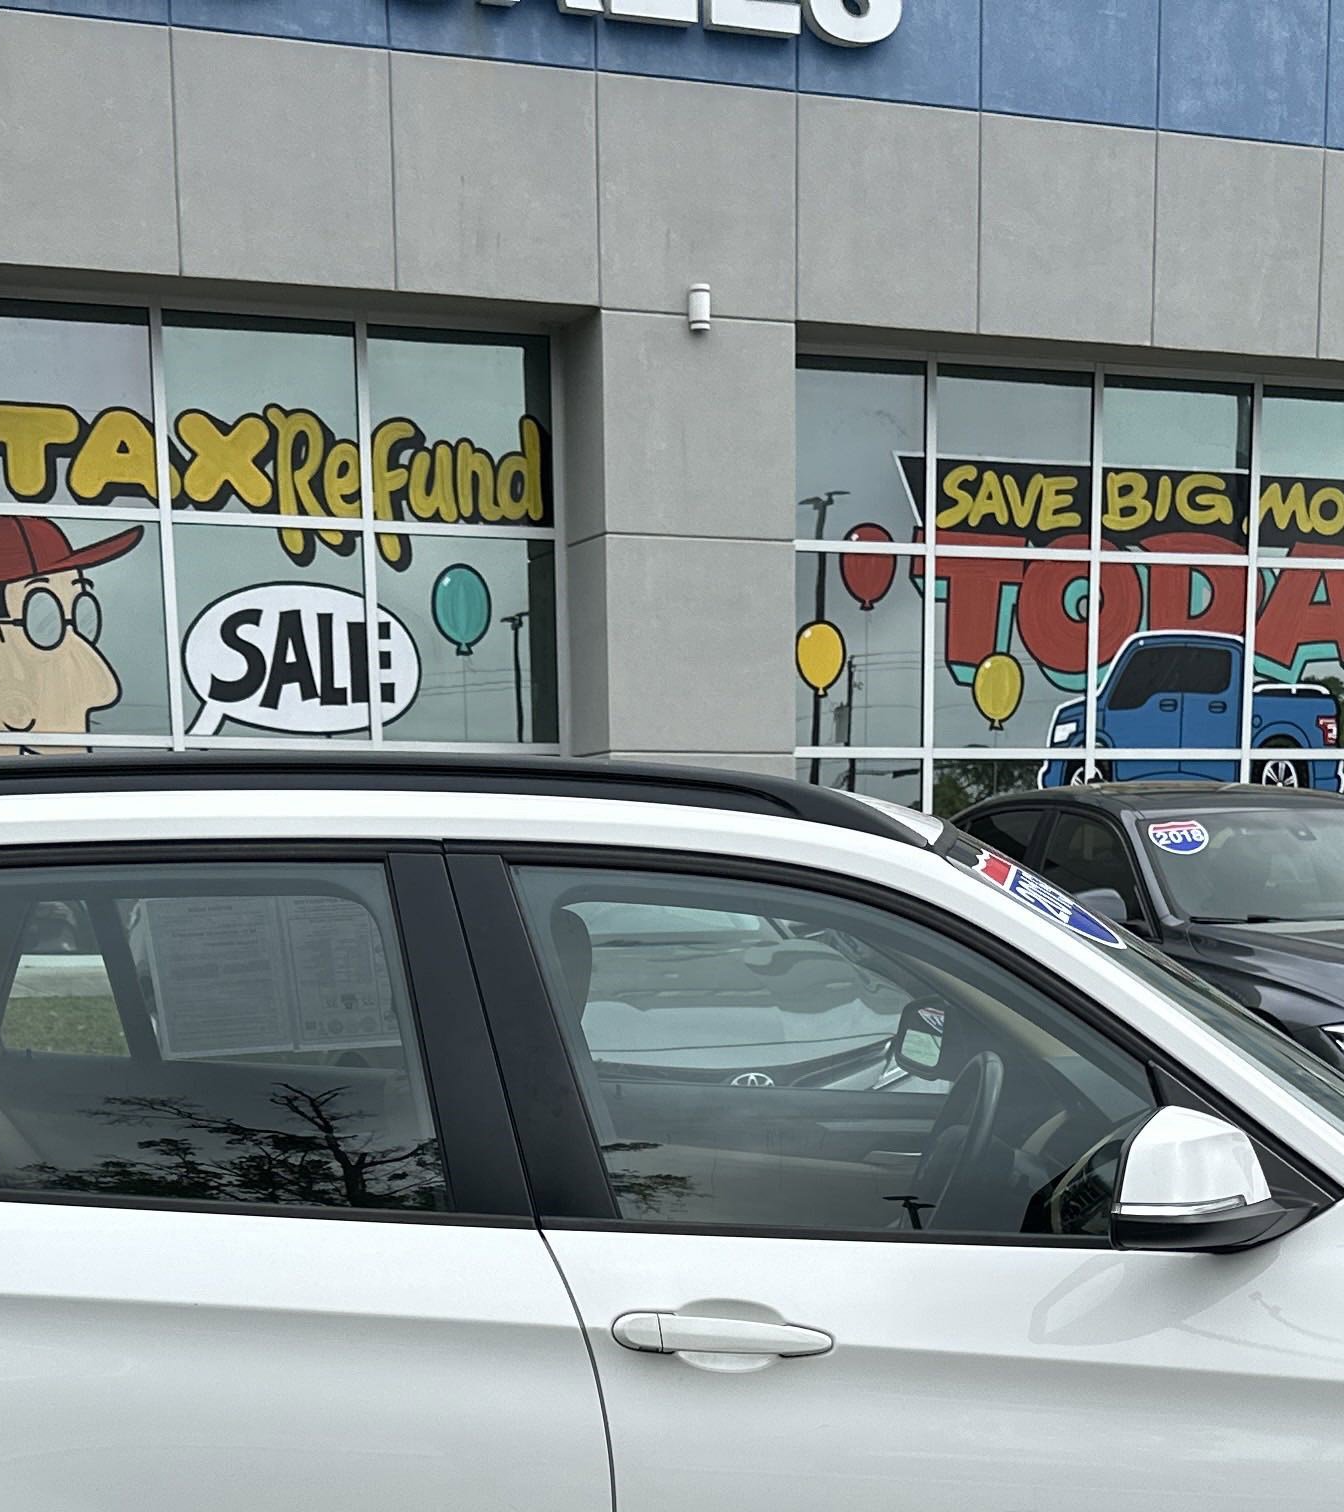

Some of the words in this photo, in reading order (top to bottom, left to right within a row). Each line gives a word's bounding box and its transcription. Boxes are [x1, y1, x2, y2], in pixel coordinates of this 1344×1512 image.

[263, 403, 553, 571] Refund
[936, 464, 1082, 532] SAVE
[1102, 471, 1235, 532] BIG
[208, 608, 396, 709] SALE
[1155, 828, 1205, 845] 2018
